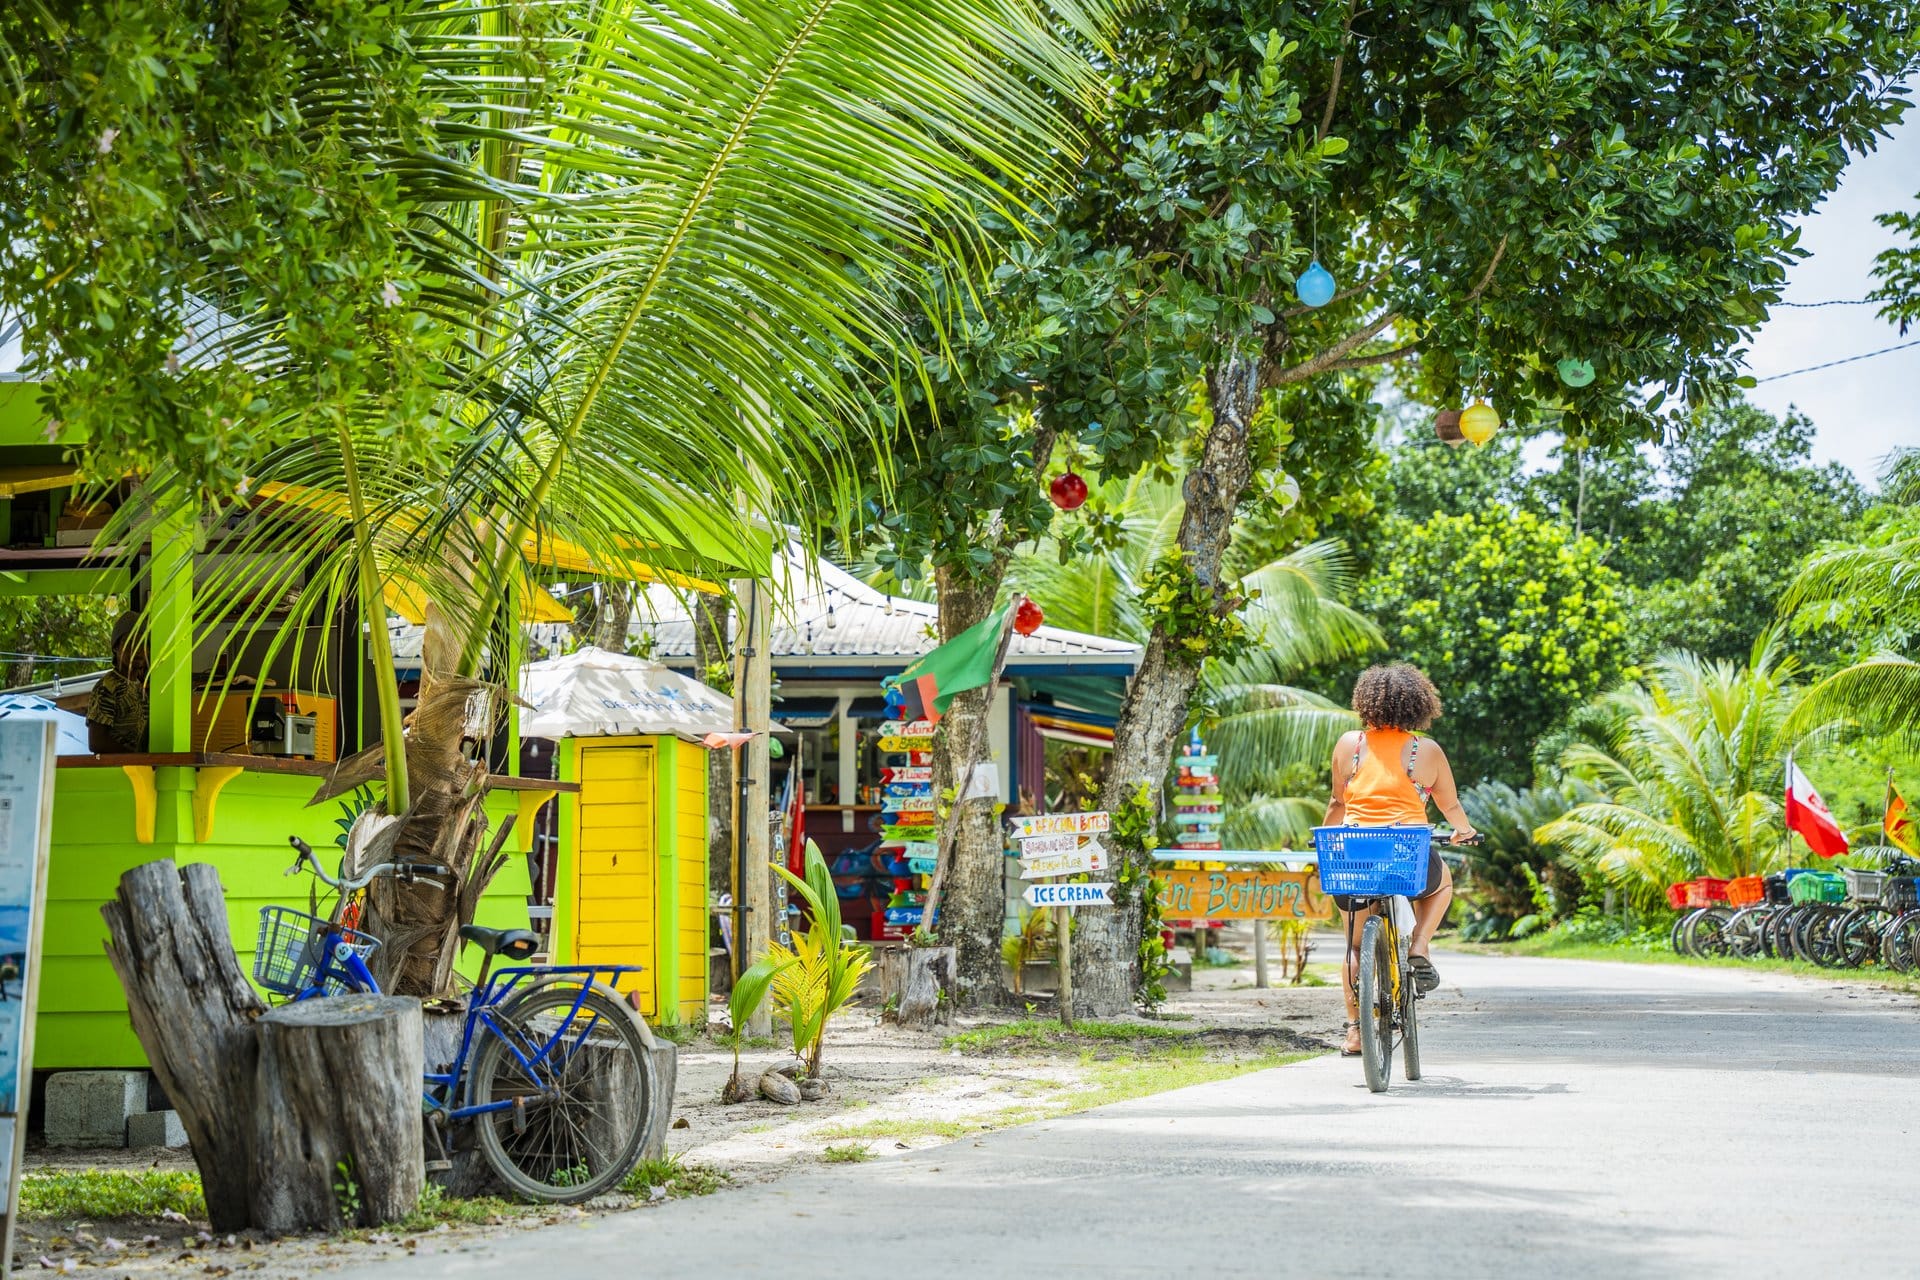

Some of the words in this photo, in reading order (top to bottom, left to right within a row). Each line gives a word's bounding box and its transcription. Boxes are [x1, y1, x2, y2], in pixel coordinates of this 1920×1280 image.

[775, 834, 790, 945] REYCLING
[1034, 887, 1055, 903] ICE
[1059, 887, 1104, 902] CREAM
[1206, 873, 1305, 917] Bottom
